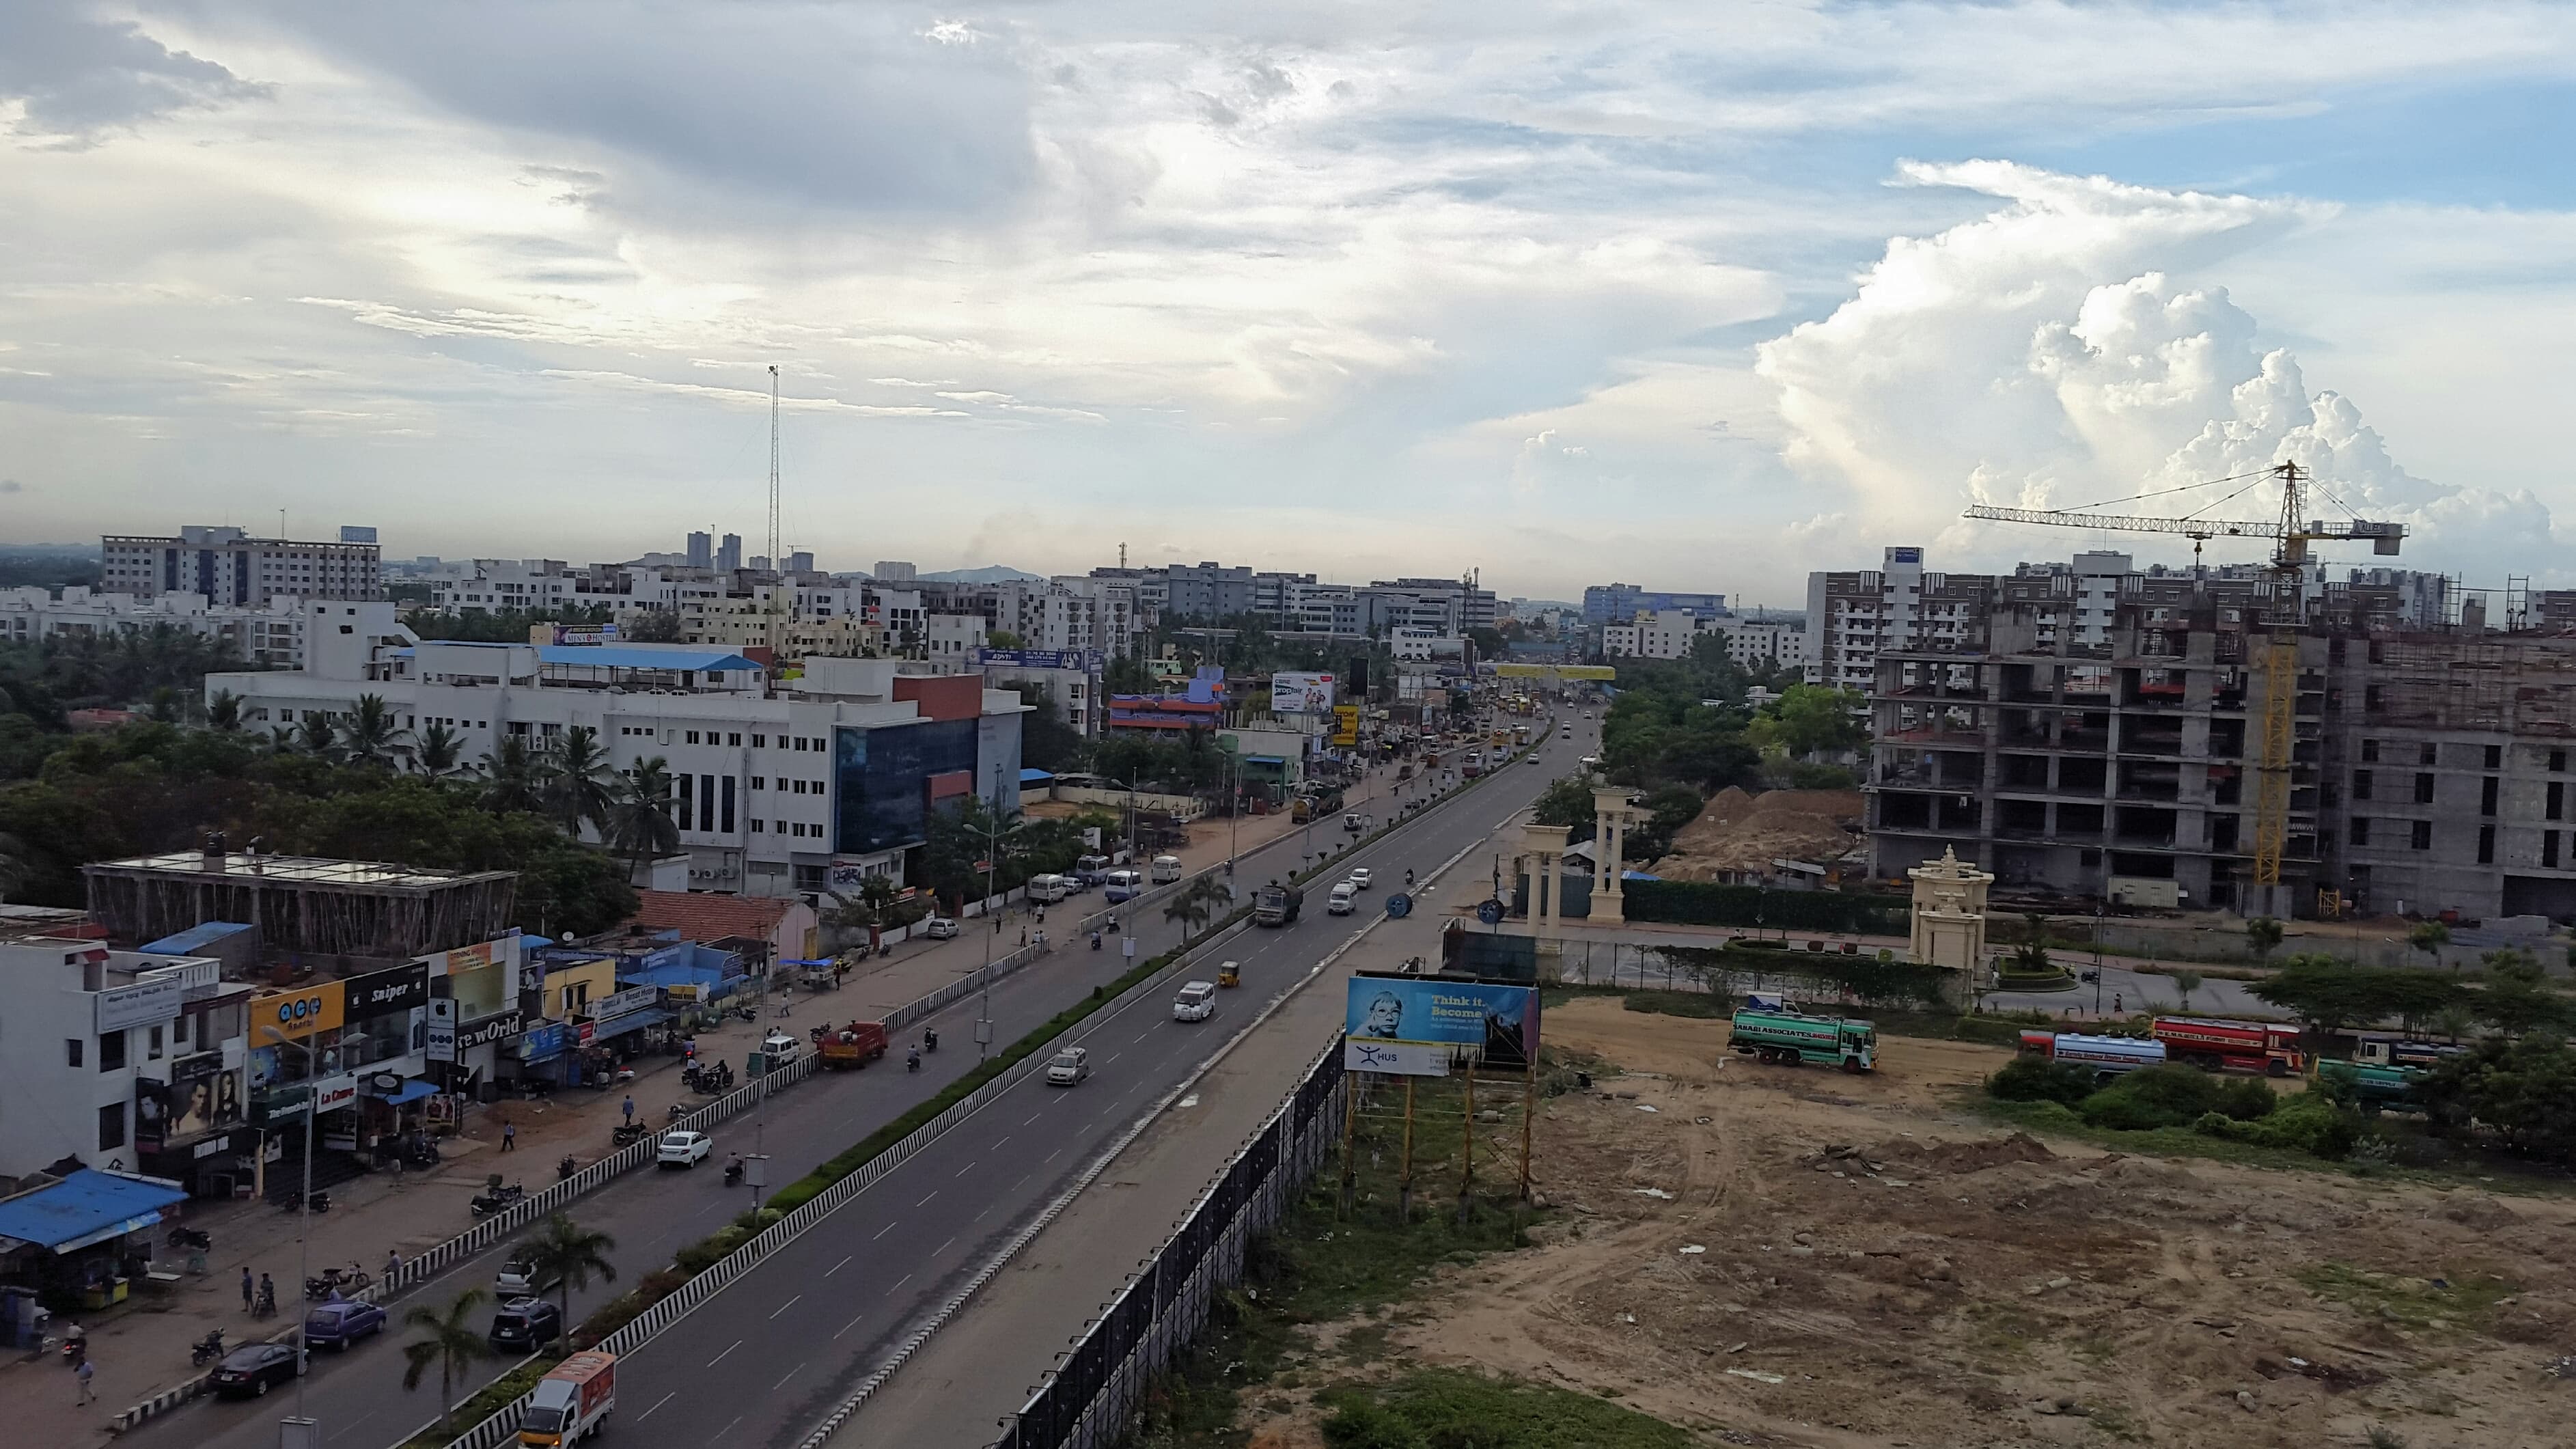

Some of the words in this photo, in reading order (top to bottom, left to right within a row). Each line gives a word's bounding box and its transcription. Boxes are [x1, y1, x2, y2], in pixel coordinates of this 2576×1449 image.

[1431, 995, 1469, 1007] Think
[1472, 996, 1486, 1008] it.
[1431, 1006, 1482, 1019] Become
[1762, 1028, 1812, 1038] ASSOCIATES
[1378, 1053, 1397, 1062] HUS
